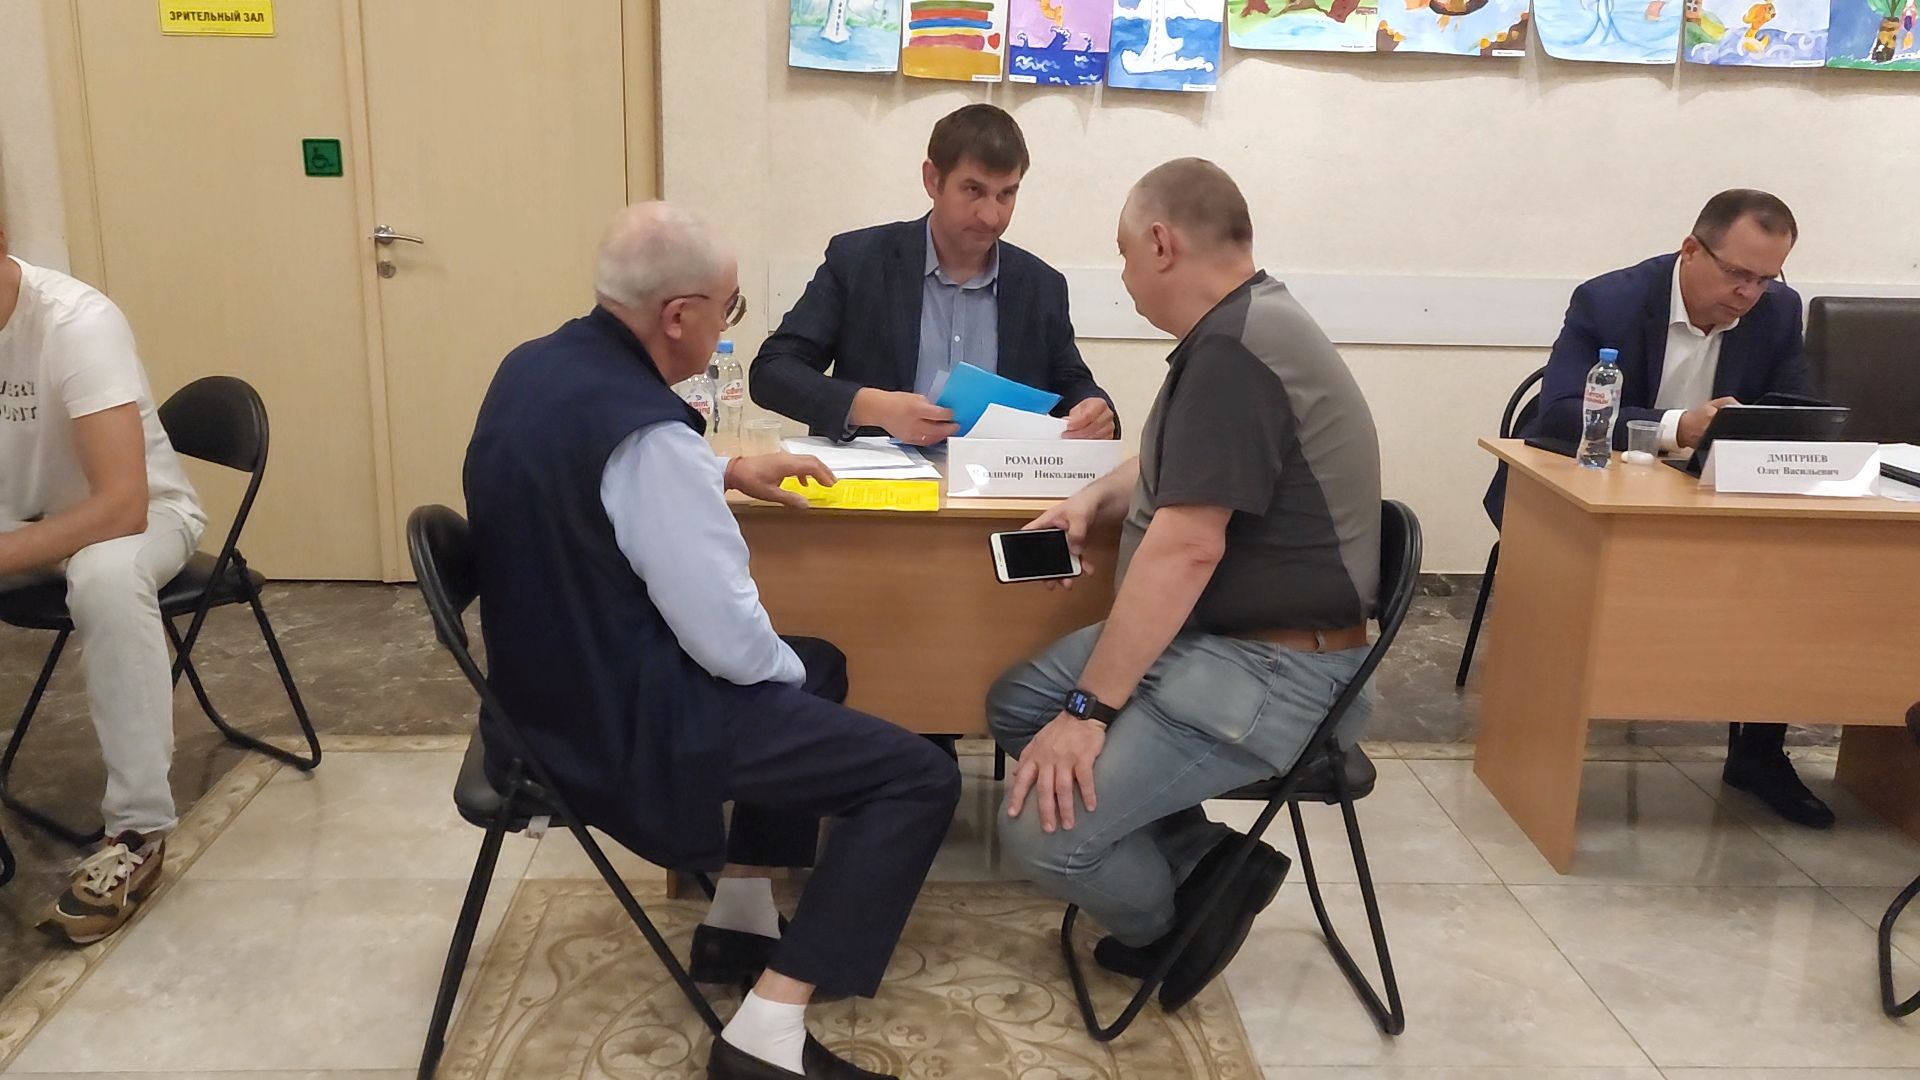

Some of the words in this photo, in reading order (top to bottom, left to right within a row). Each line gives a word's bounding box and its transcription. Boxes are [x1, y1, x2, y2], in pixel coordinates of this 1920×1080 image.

[169, 10, 241, 22] ЗРИТЕЛЬНЫЙ
[243, 12, 264, 22] ЗАЛ
[1005, 455, 1064, 466] РОМАНОВ
[1767, 453, 1829, 463] ДМИТРИЕВ
[972, 469, 1024, 481] димир
[1034, 469, 1096, 480] Николаевич
[1757, 466, 1780, 476] Олег
[1783, 466, 1839, 476] Васильевич
